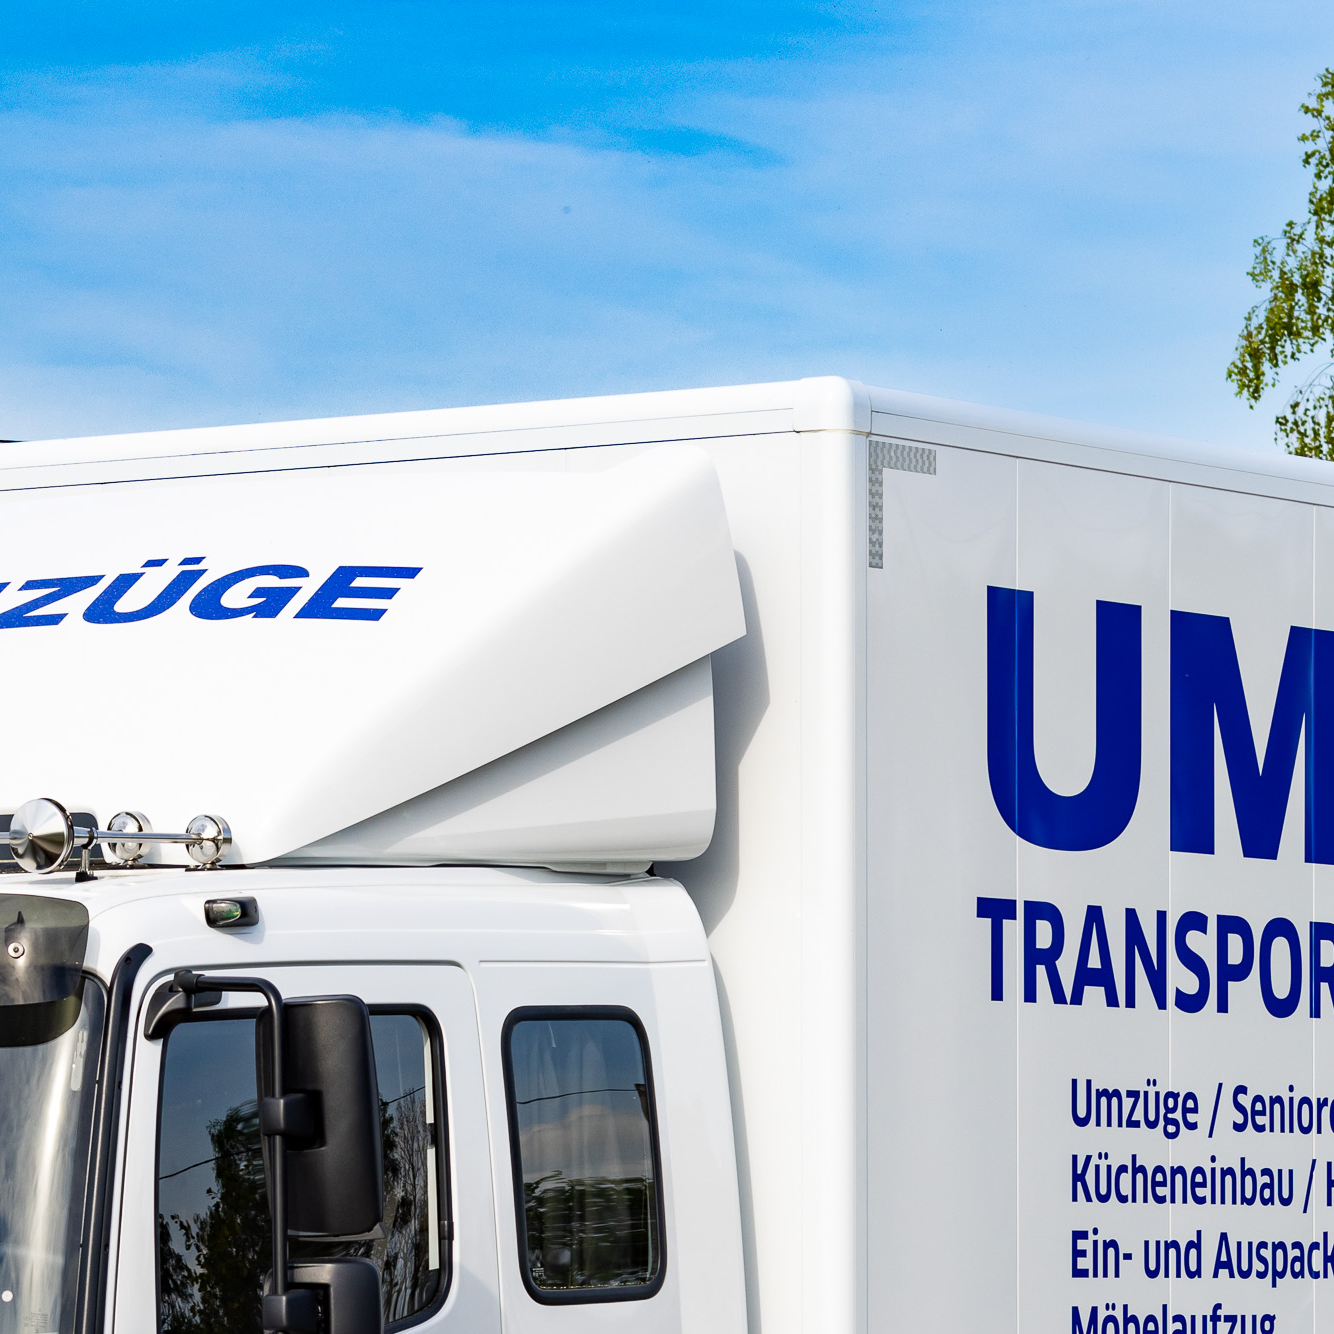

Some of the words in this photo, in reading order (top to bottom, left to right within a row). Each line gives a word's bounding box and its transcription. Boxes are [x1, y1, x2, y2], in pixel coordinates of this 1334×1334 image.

[1071, 1078, 1199, 1140] Umzüge
[1207, 1082, 1224, 1139] /
[1071, 1151, 1294, 1207] Kücheneinbau
[1302, 1158, 1317, 1214] /
[1071, 1226, 1133, 1279] Ein-
[1143, 1229, 1203, 1280] und
